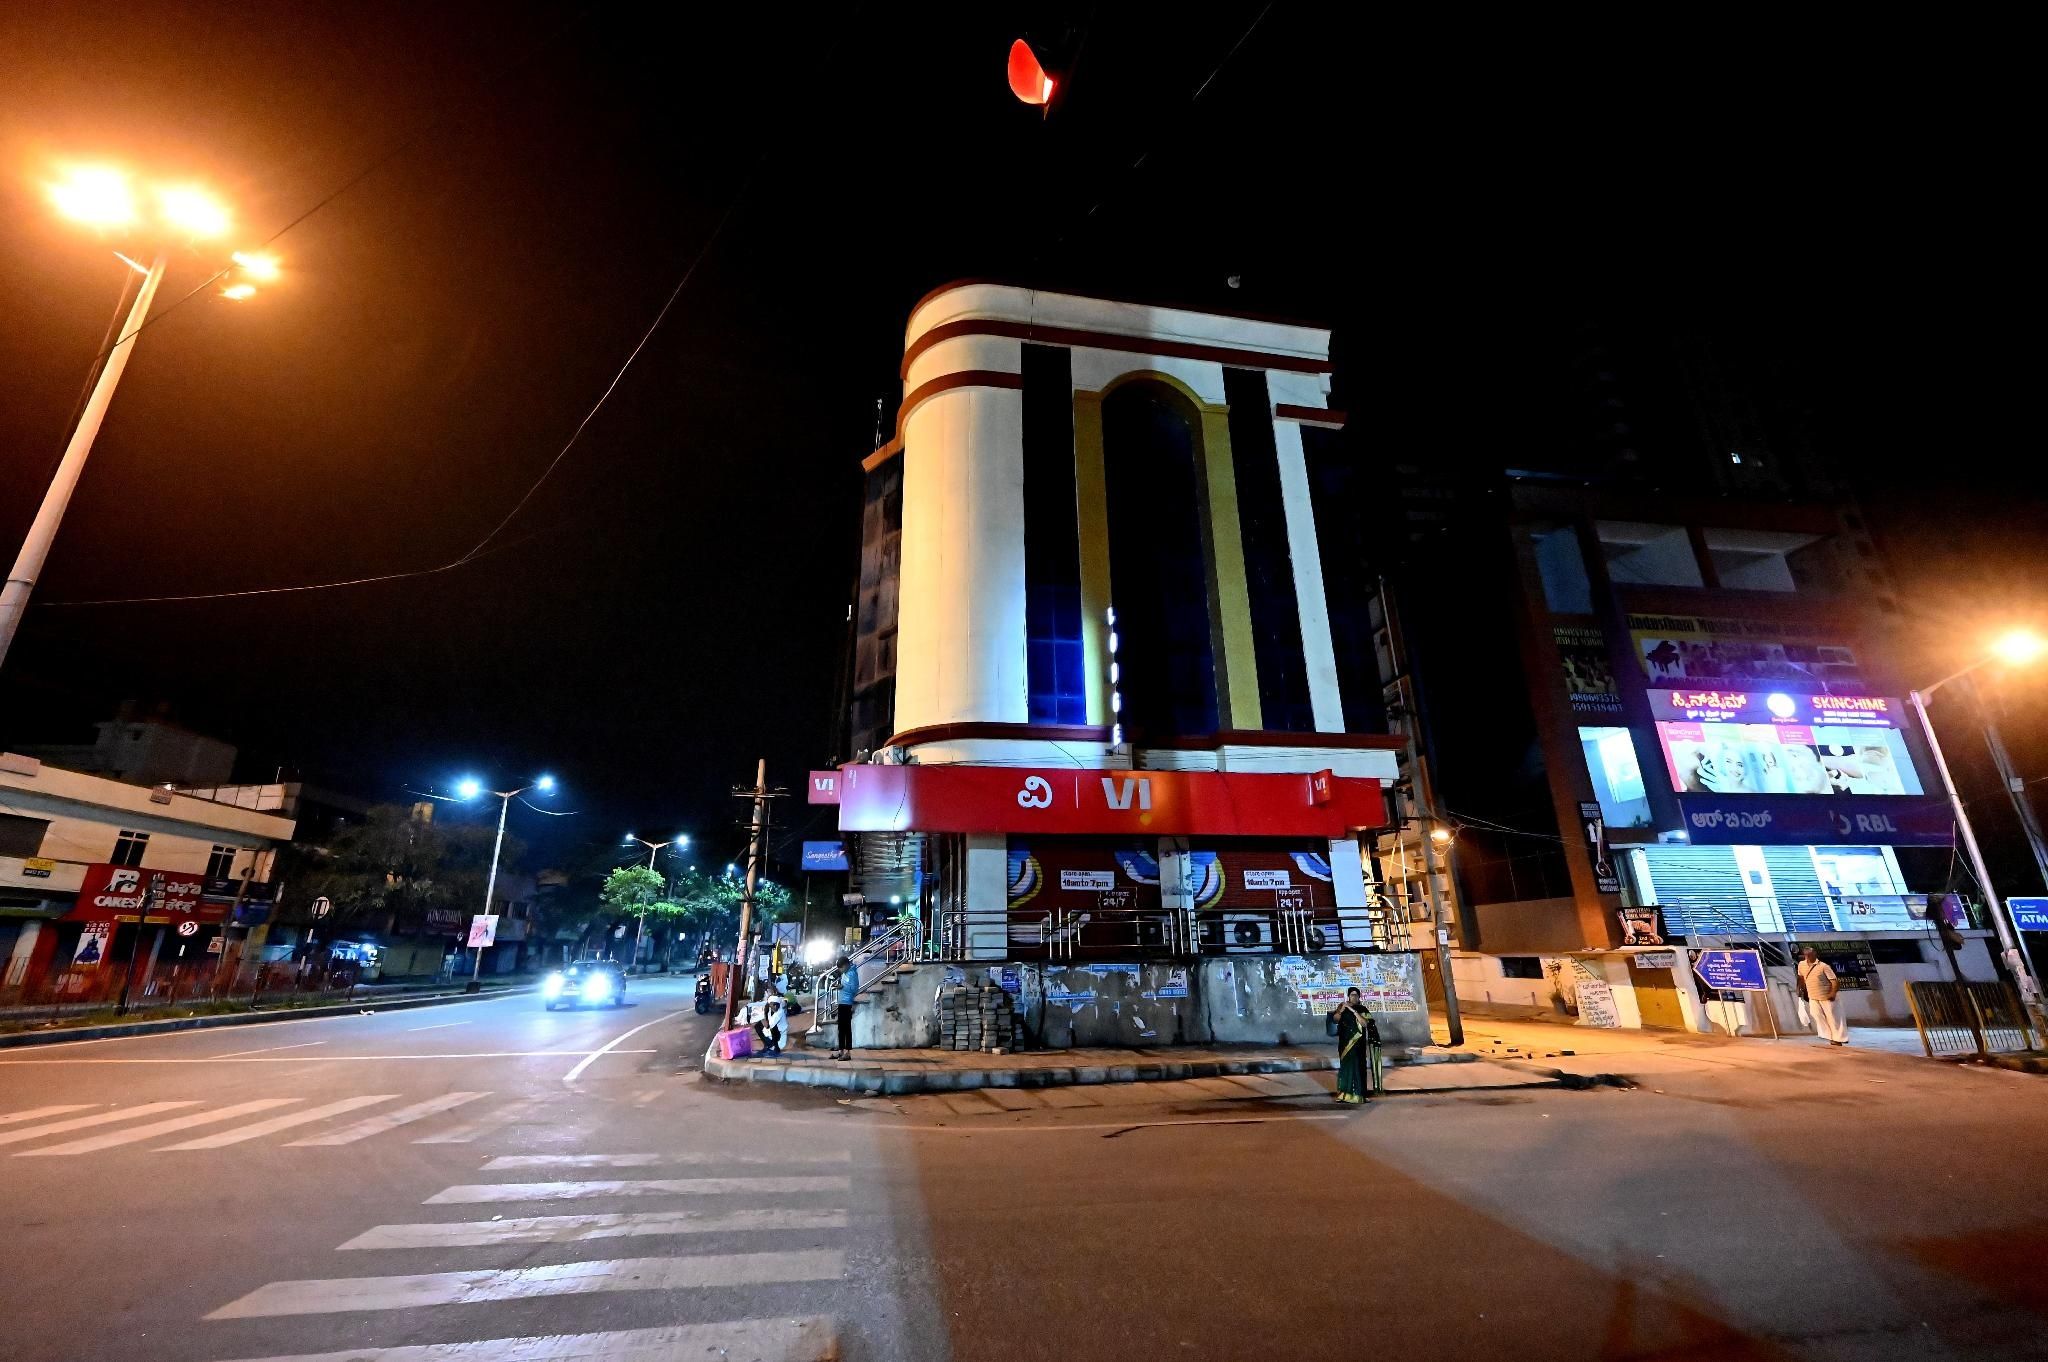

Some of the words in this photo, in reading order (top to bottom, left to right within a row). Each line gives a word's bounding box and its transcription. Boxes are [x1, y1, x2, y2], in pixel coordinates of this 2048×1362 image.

[1812, 696, 1888, 711] SKINCHIME
[1855, 814, 1897, 832] RBL
[1847, 901, 1876, 915] 7.5%
[2021, 914, 2048, 924] ATM
